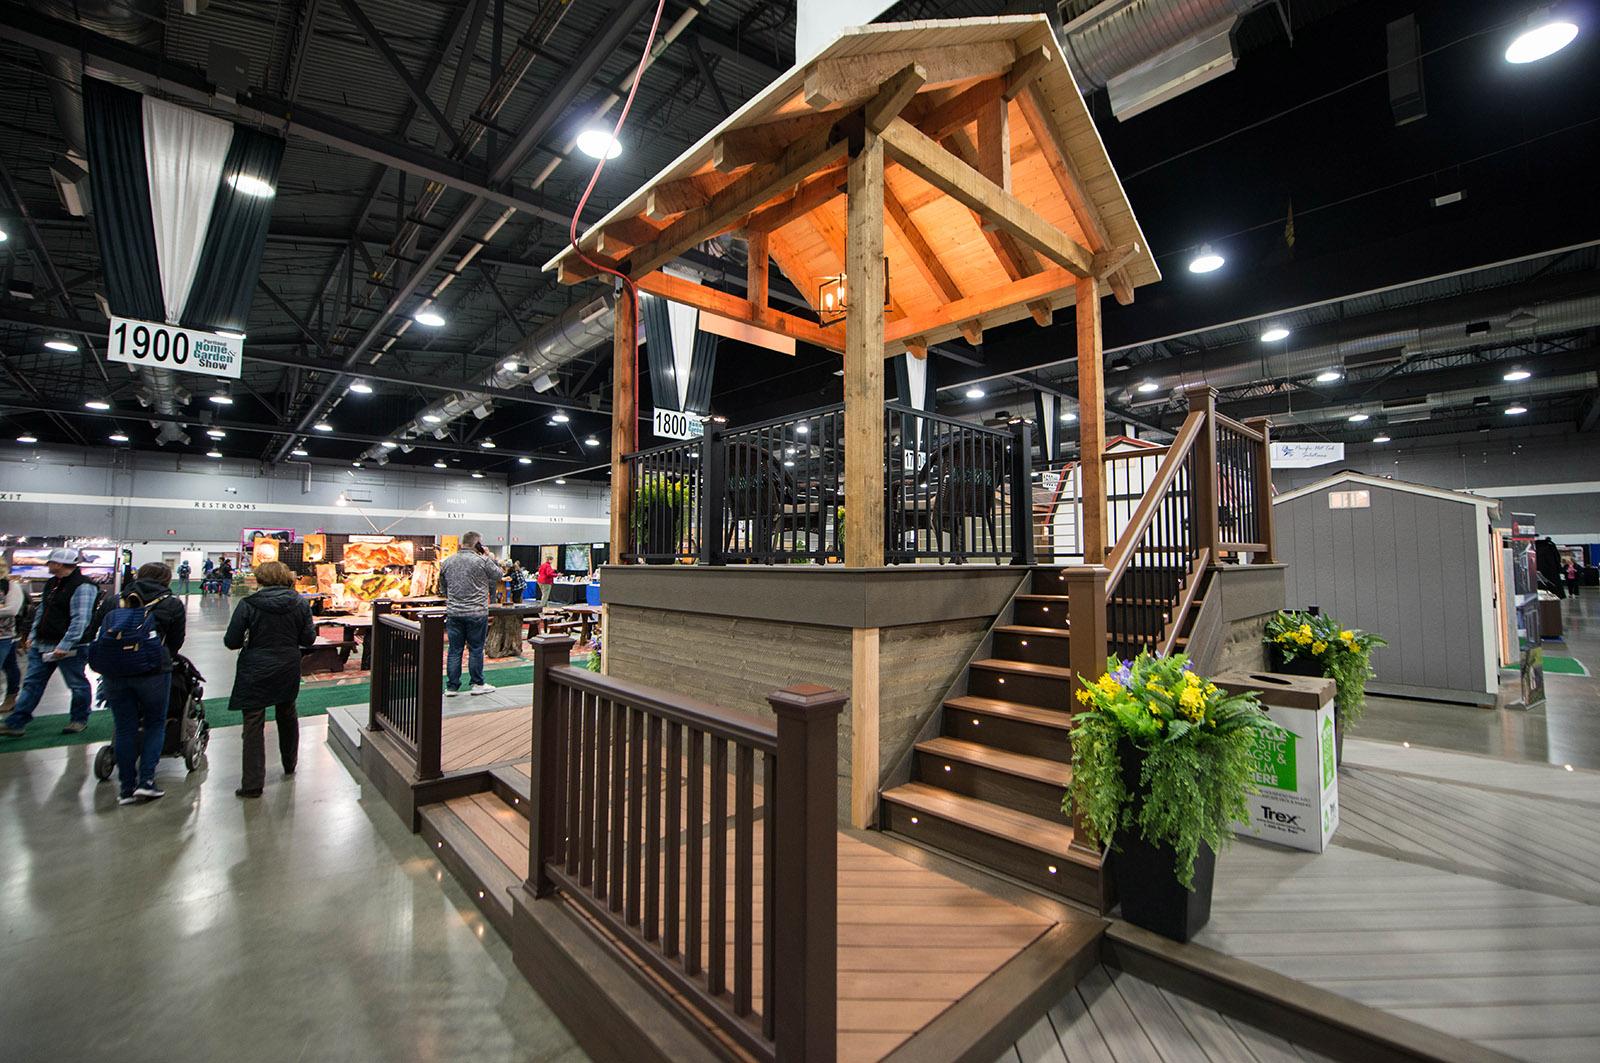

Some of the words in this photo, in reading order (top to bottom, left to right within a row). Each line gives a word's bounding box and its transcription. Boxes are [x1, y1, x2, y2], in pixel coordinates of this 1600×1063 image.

[114, 322, 189, 364] 1900
[195, 341, 228, 354] Home
[193, 350, 233, 363] Garden
[199, 359, 227, 370] Show
[656, 411, 686, 436] 1800
[194, 502, 256, 510] RESTROOMS
[1277, 753, 1287, 765] &
[1260, 805, 1299, 826] Trex
